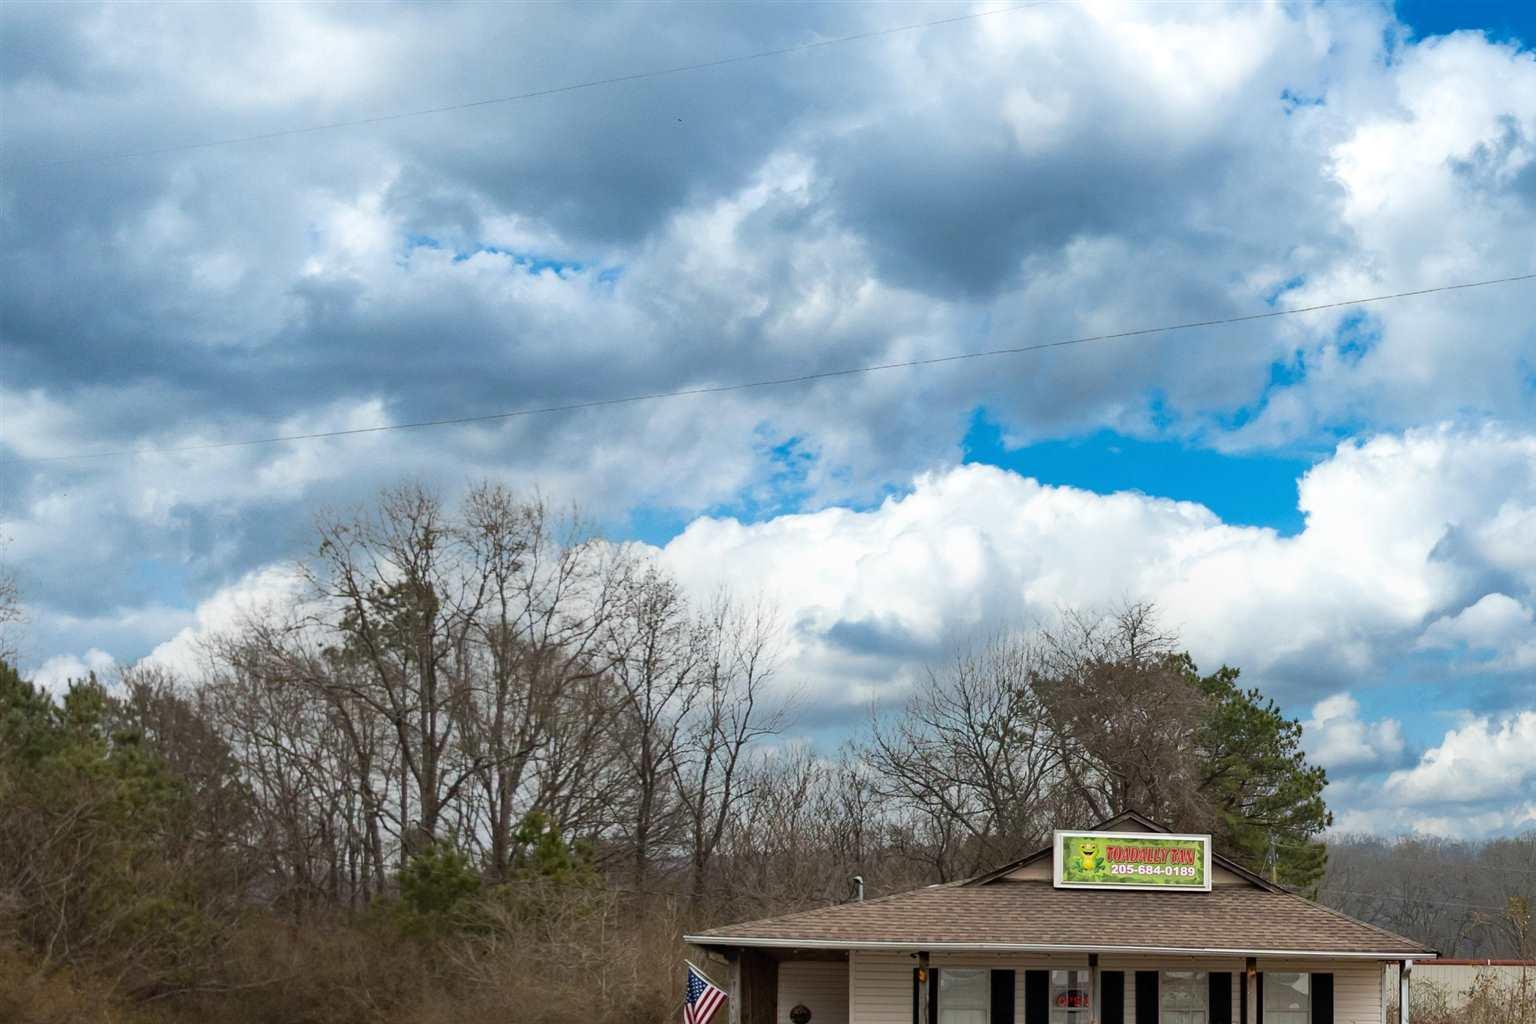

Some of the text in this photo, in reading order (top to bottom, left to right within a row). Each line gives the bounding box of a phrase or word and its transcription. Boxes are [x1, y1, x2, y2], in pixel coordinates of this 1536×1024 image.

[1106, 846, 1196, 865] TOADALLY TAN
[1111, 864, 1196, 877] 205-684-0189
